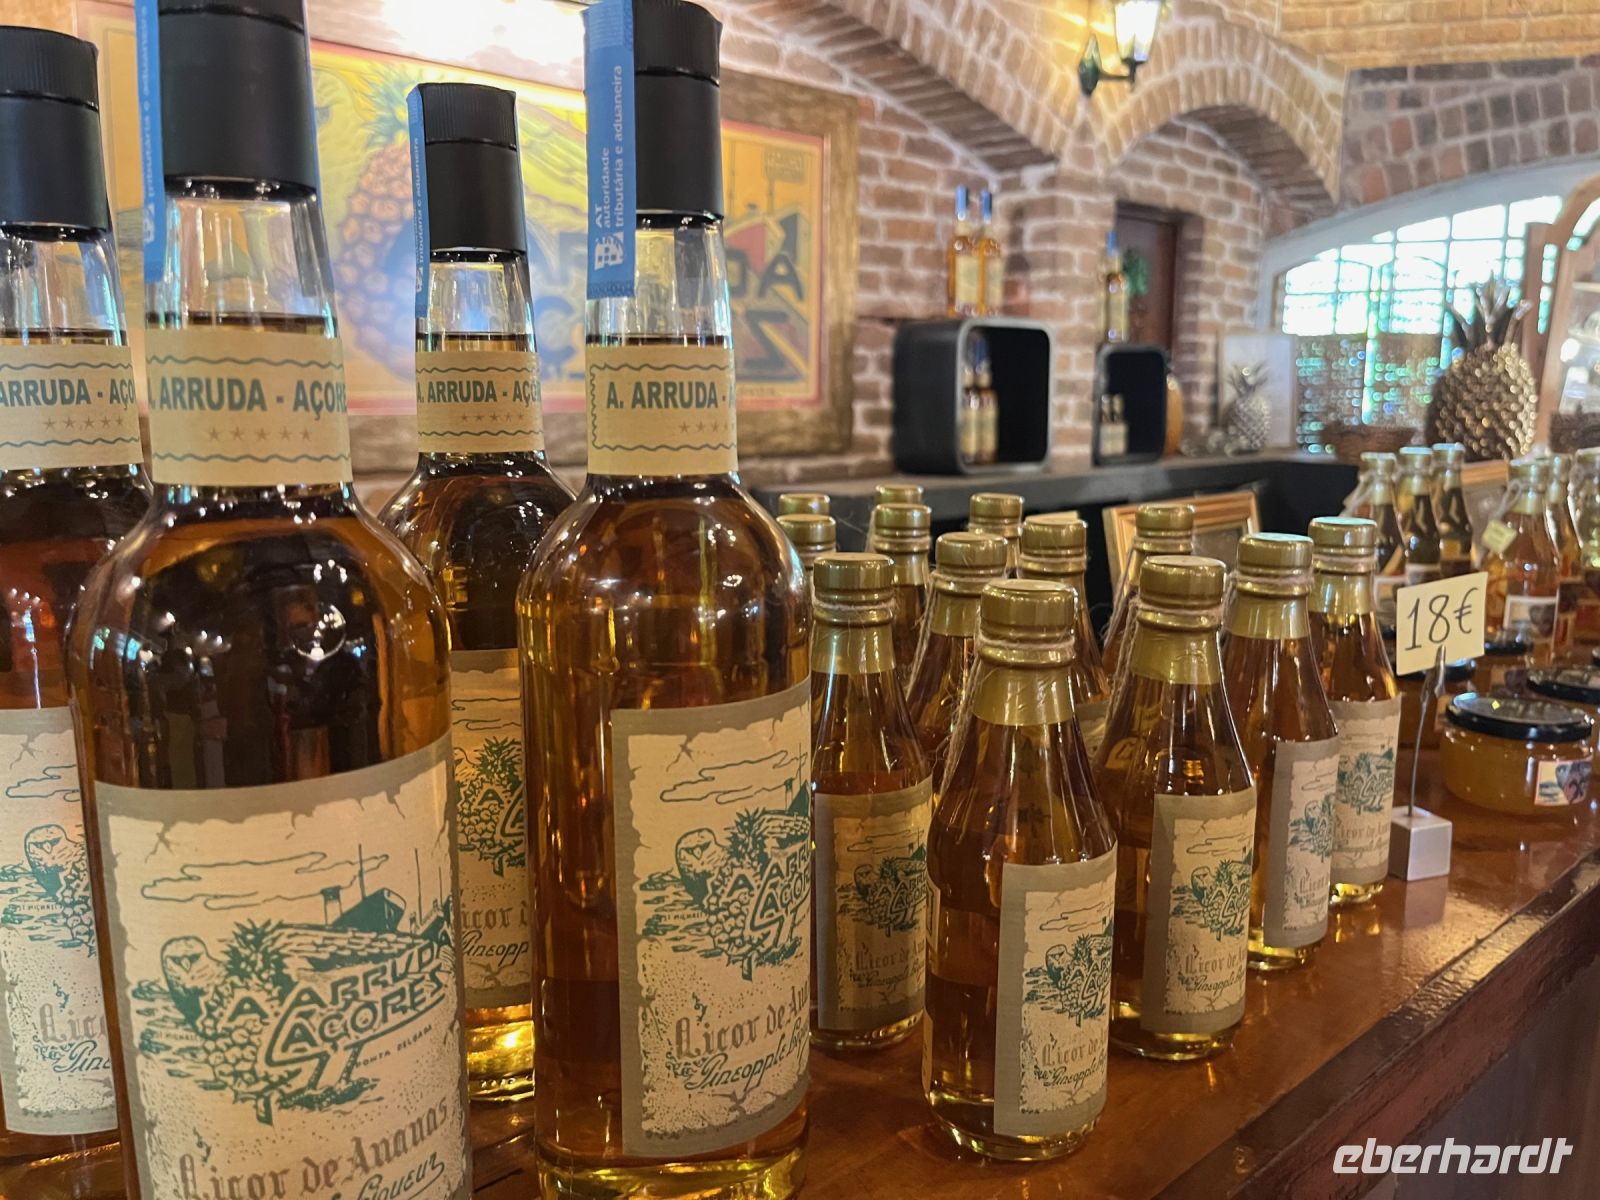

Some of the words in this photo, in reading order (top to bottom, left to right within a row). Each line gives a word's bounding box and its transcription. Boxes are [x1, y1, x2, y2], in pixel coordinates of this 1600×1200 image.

[611, 65, 623, 142] aduaneira
[615, 145, 623, 155] e
[601, 147, 610, 229] autoridade
[613, 159, 624, 228] tributária
[0, 378, 91, 407] ARRUDA
[159, 376, 267, 412] ARRUDA
[427, 380, 498, 404] ARRUDA
[606, 381, 624, 409] A.
[631, 381, 718, 409] ARRUDA
[1405, 587, 1479, 651] 18€
[461, 902, 514, 930] icor
[227, 996, 269, 1022] A
[281, 962, 448, 1054] AÇORES
[675, 1017, 761, 1060] Licor
[764, 1004, 786, 1036] de
[684, 1032, 786, 1092] Pineapple
[1042, 1043, 1085, 1067] Licor
[179, 1153, 291, 1200] Licor
[302, 1155, 341, 1194] de
